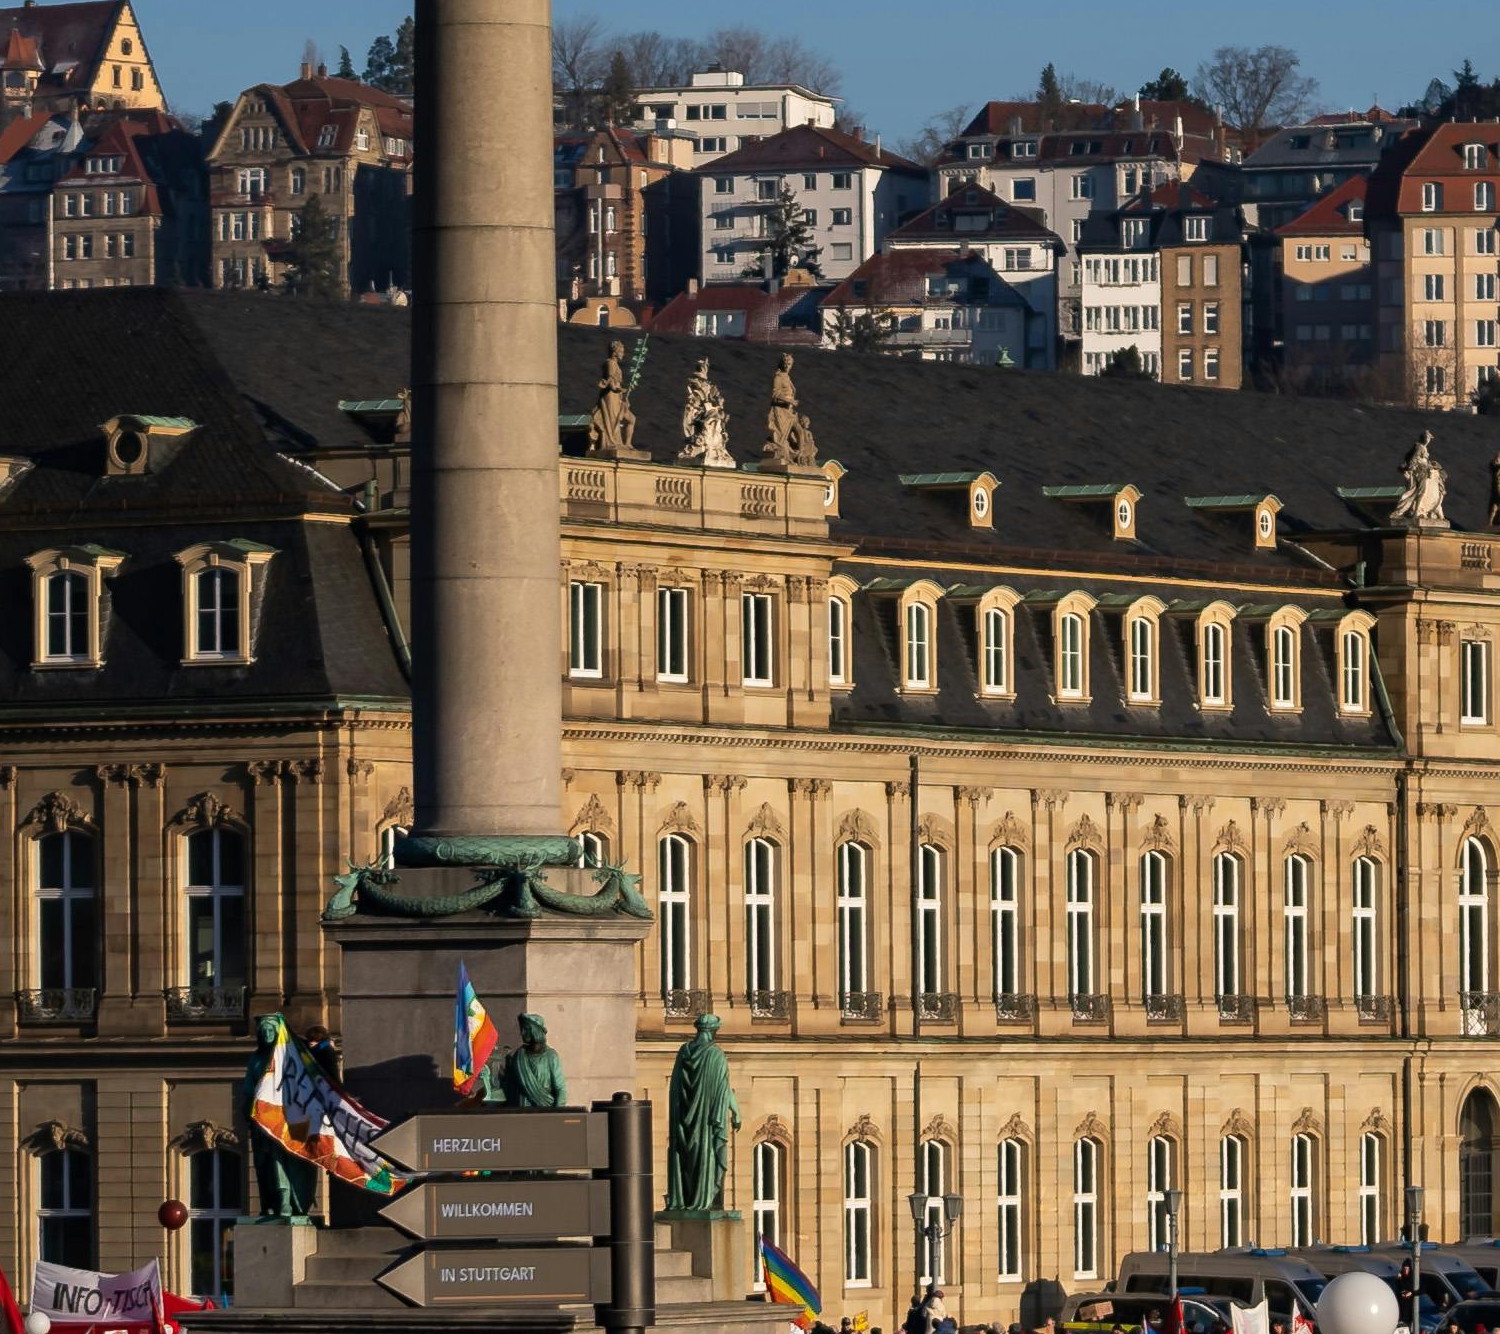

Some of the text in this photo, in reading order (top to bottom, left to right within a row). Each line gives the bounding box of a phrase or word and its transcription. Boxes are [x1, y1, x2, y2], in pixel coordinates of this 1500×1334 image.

[433, 1138, 502, 1153] HERZLICH
[441, 1203, 534, 1218] WILLKOMMEN
[441, 1266, 537, 1283] IN STUTTGART
